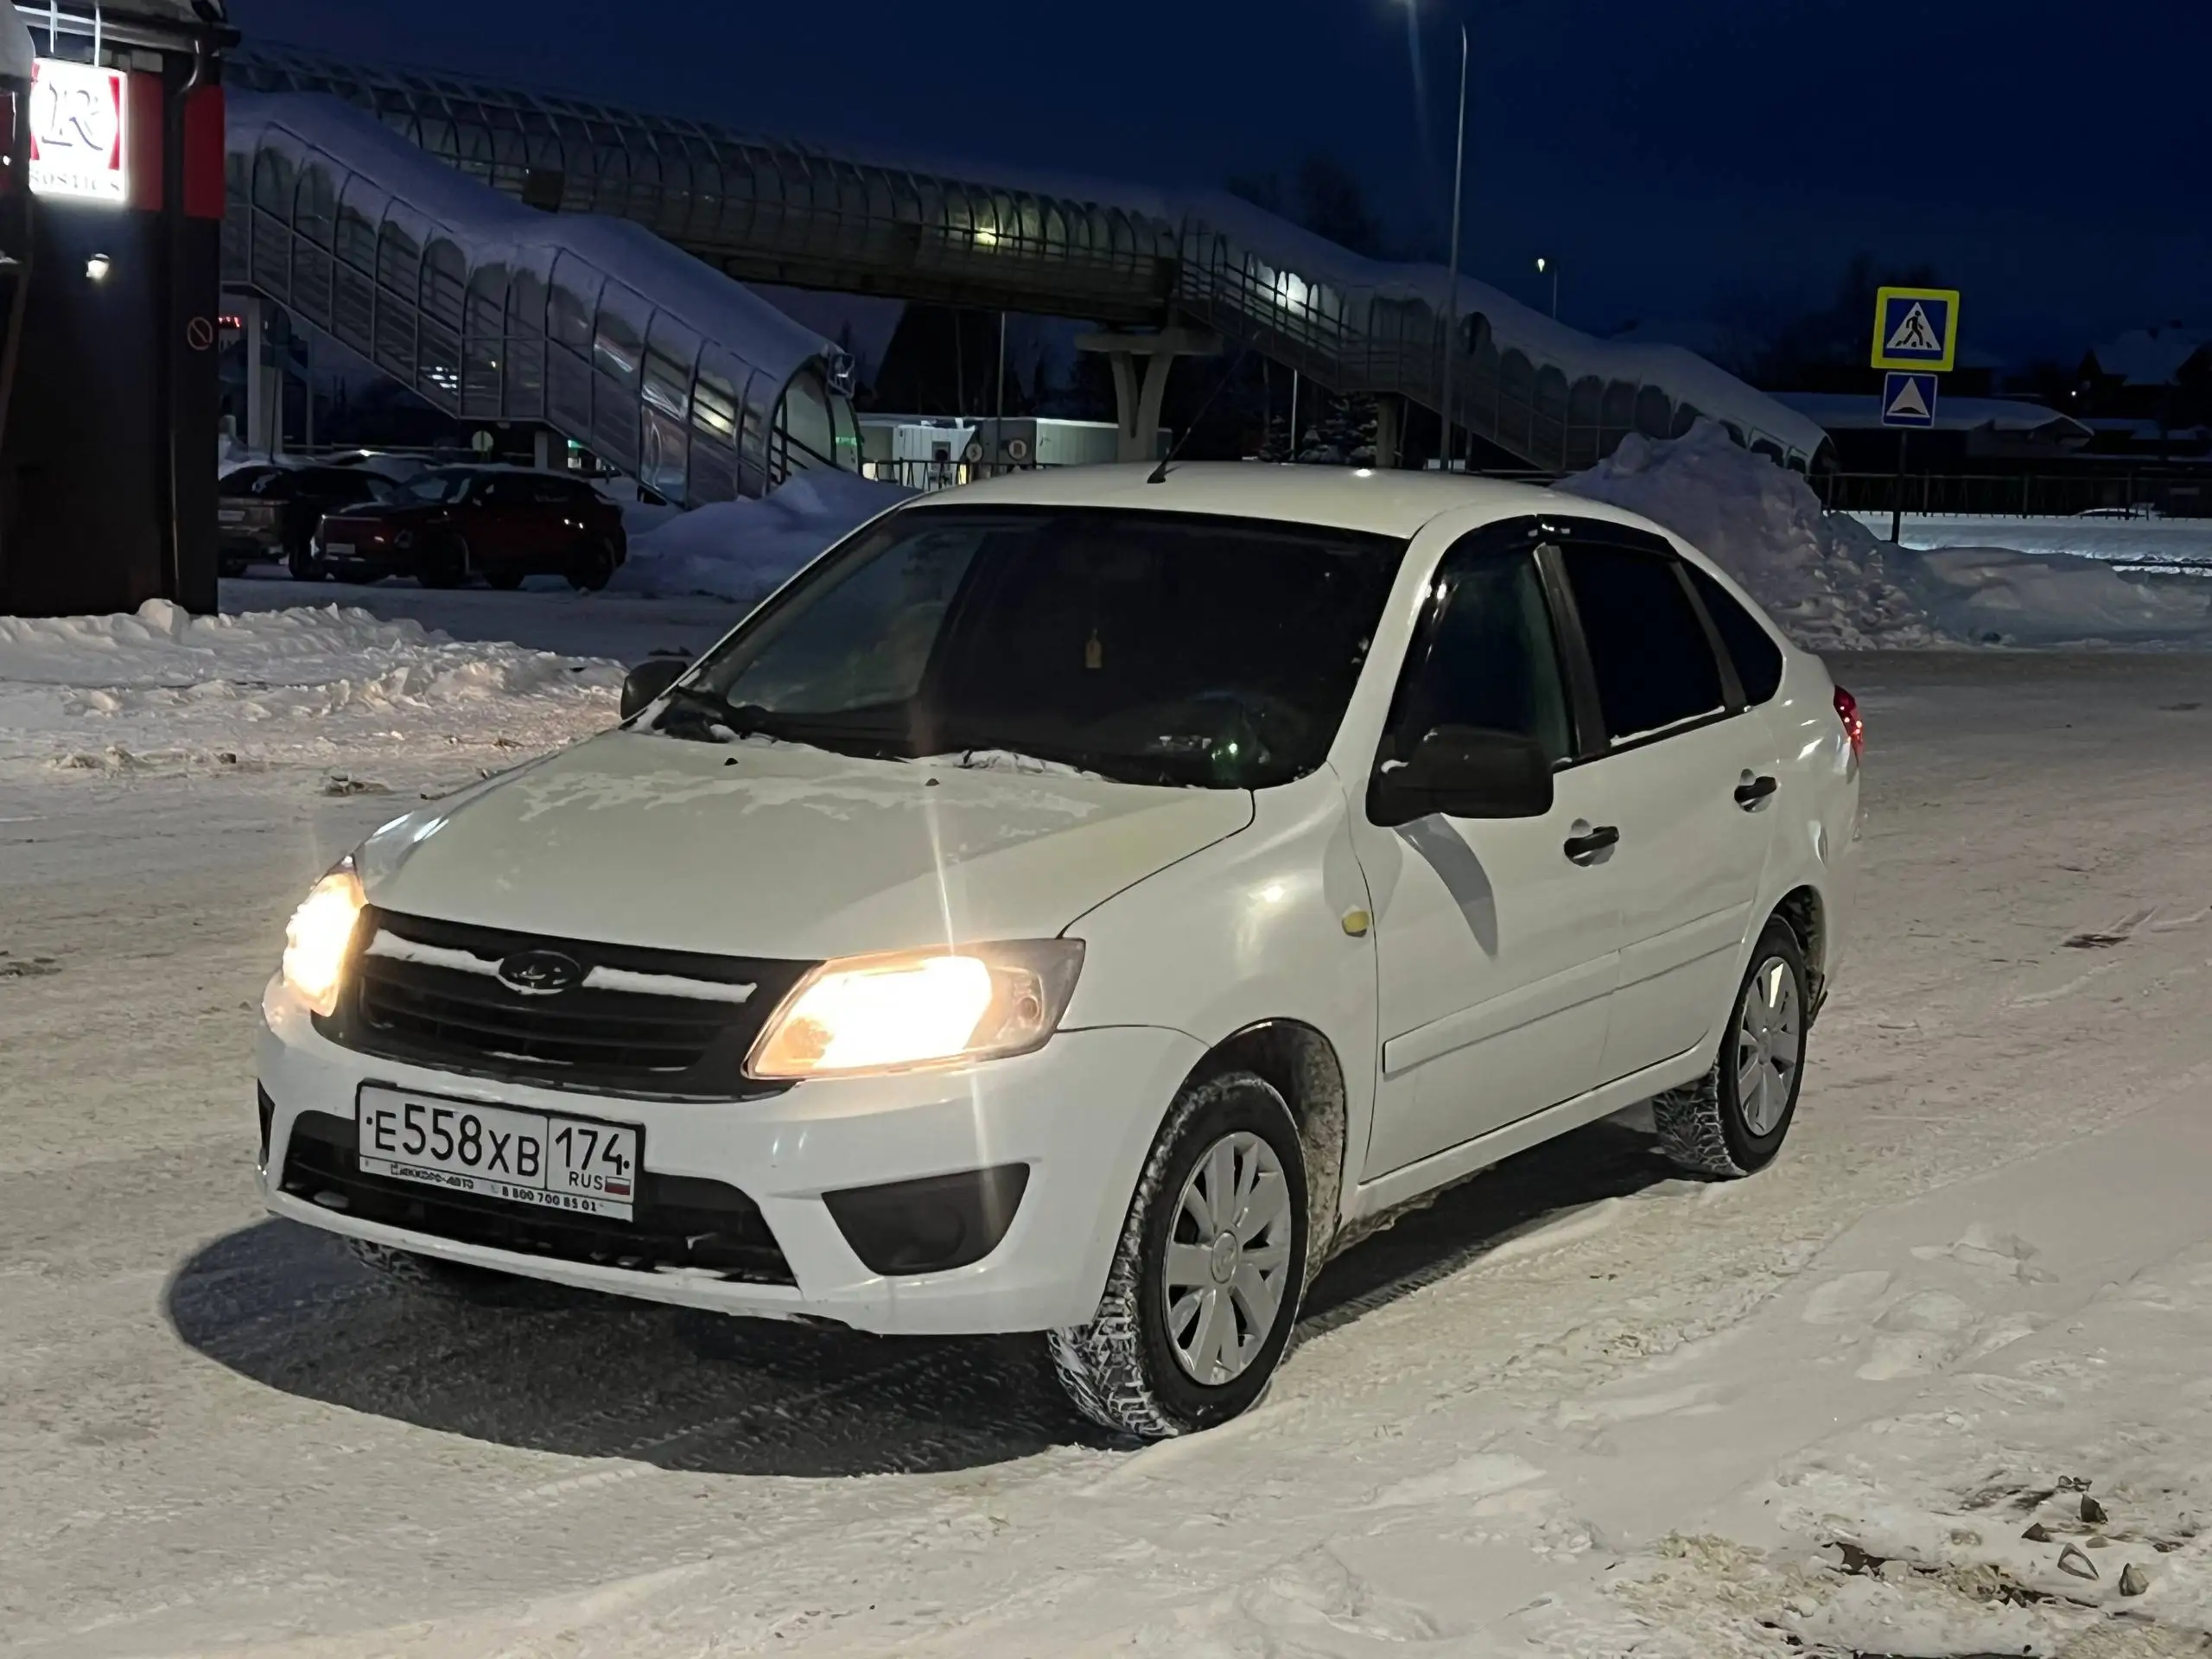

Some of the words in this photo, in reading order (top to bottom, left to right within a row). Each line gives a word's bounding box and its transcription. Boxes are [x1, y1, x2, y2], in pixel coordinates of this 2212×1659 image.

[556, 1128, 623, 1176] 174
[569, 1171, 603, 1191] RUS
[537, 1192, 560, 1205] 700
